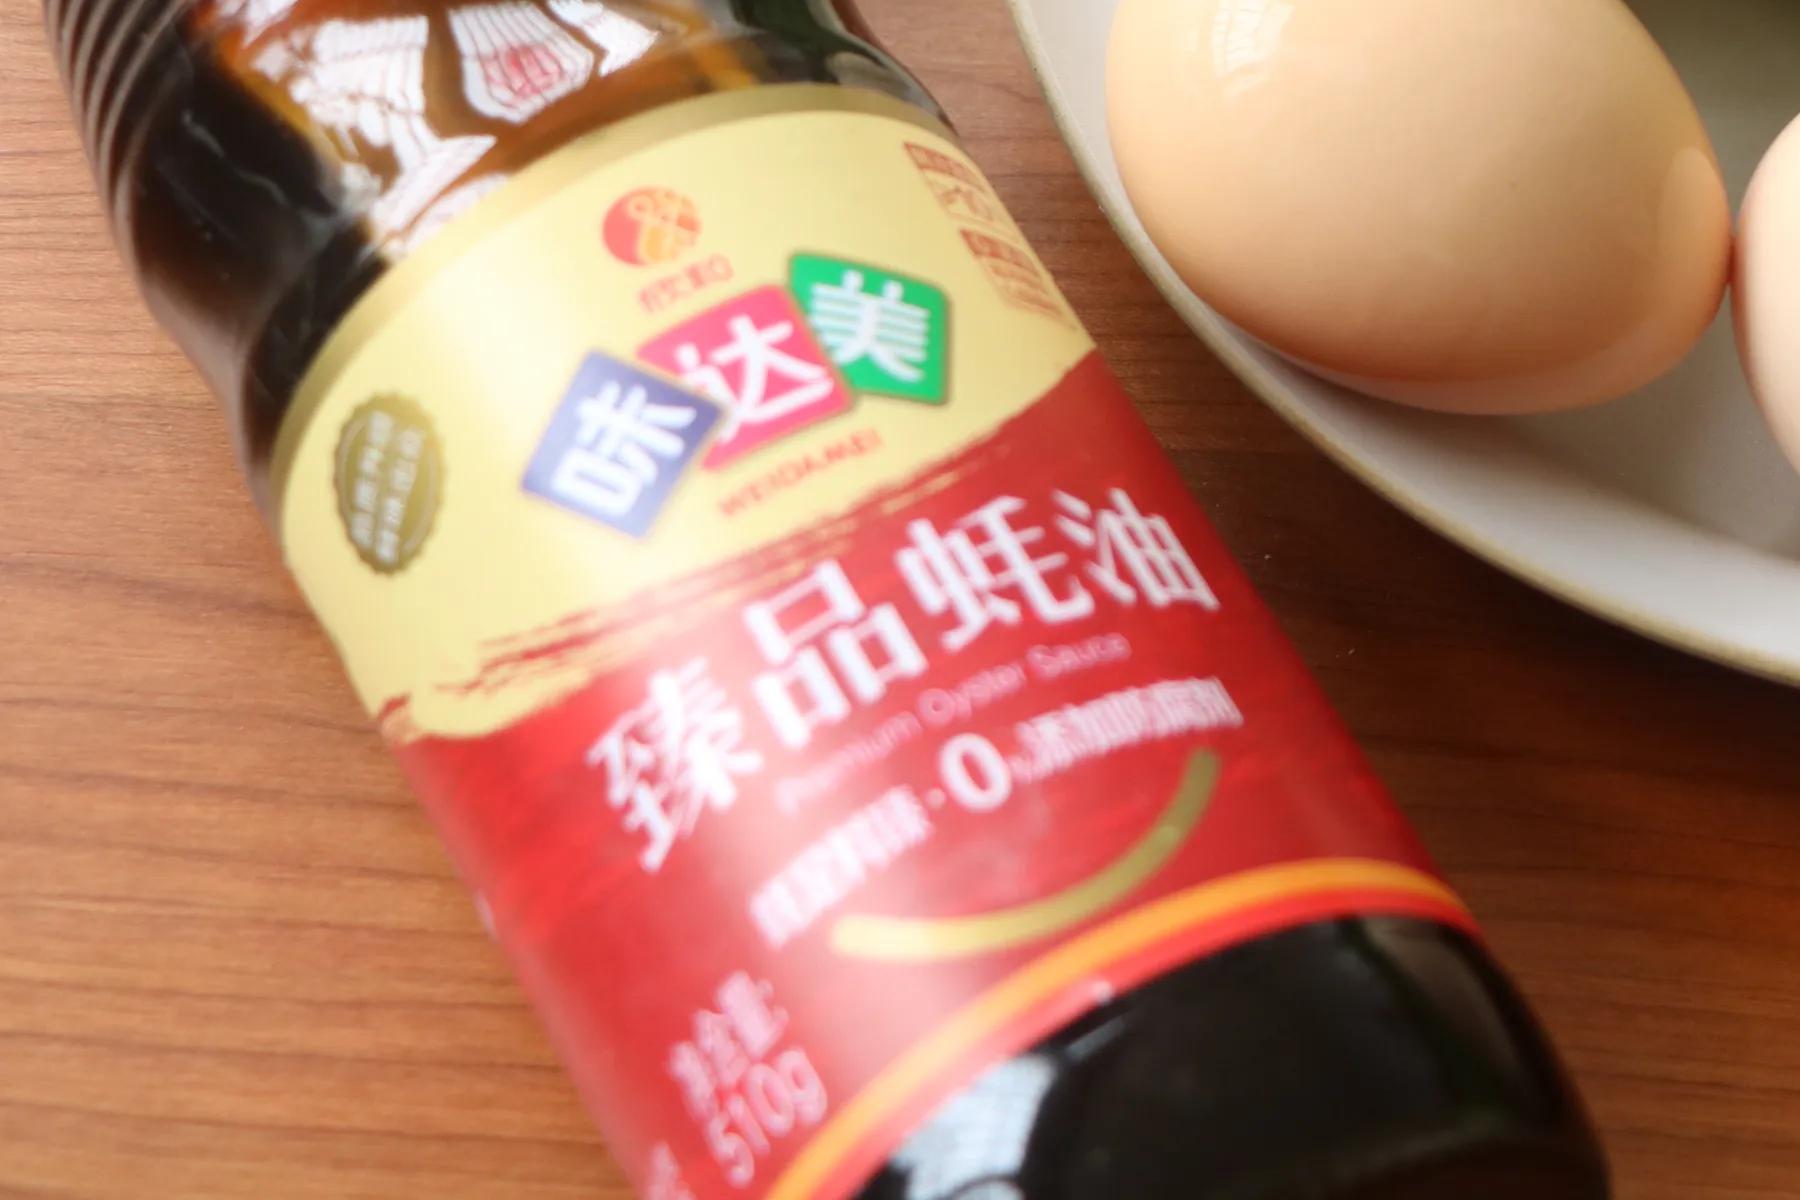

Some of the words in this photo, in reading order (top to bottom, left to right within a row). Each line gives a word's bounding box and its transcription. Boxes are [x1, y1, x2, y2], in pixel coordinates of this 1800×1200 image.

[549, 268, 931, 518] 味达美
[587, 487, 1223, 873] 臻品蚝油
[702, 1046, 828, 1187] 510g
